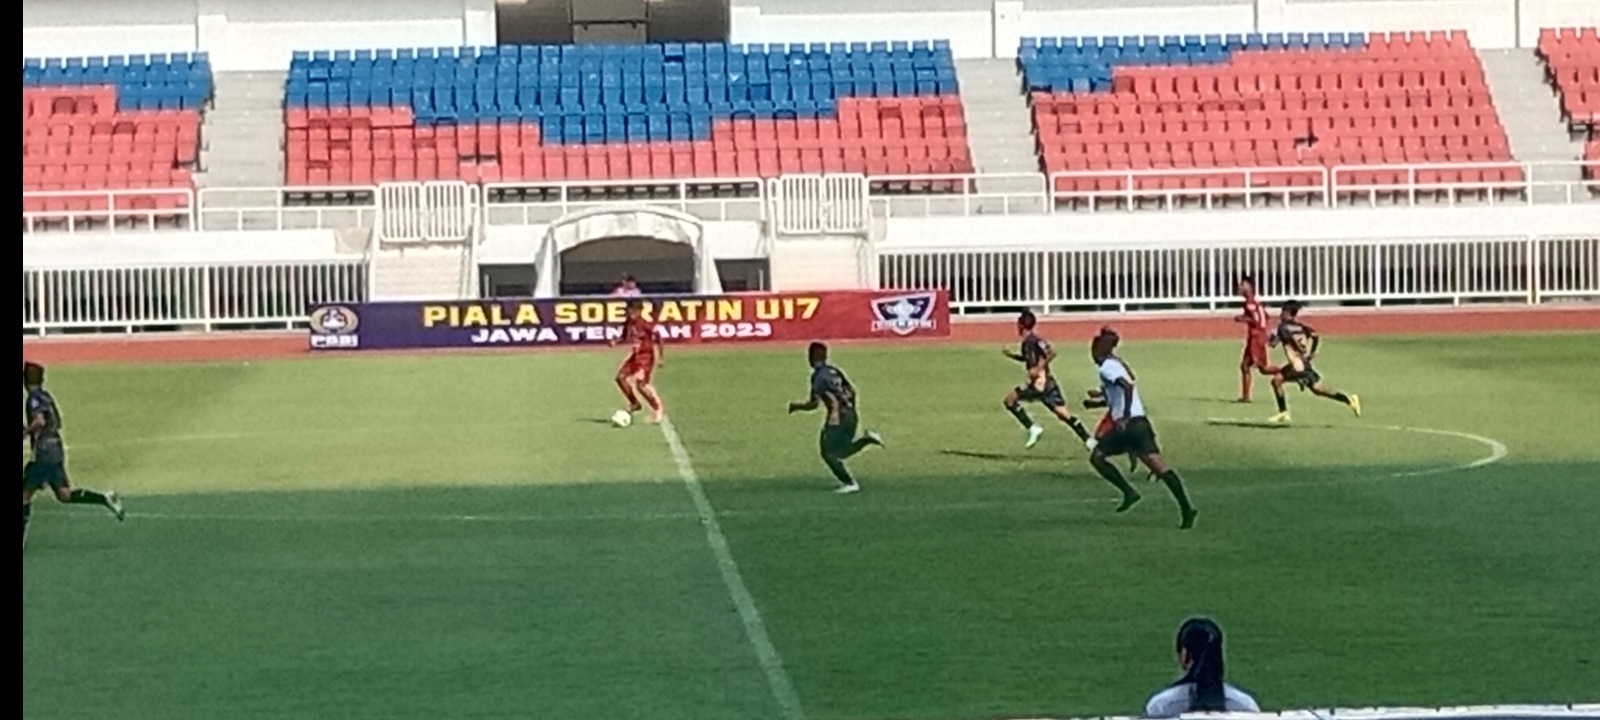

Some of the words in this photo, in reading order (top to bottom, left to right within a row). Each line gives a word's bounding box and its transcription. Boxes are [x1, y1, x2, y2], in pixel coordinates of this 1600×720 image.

[424, 303, 541, 327] PIALA
[756, 298, 820, 320] U17
[471, 327, 559, 343] JAWA
[565, 324, 692, 340] TENAH
[701, 322, 772, 338] 2023
